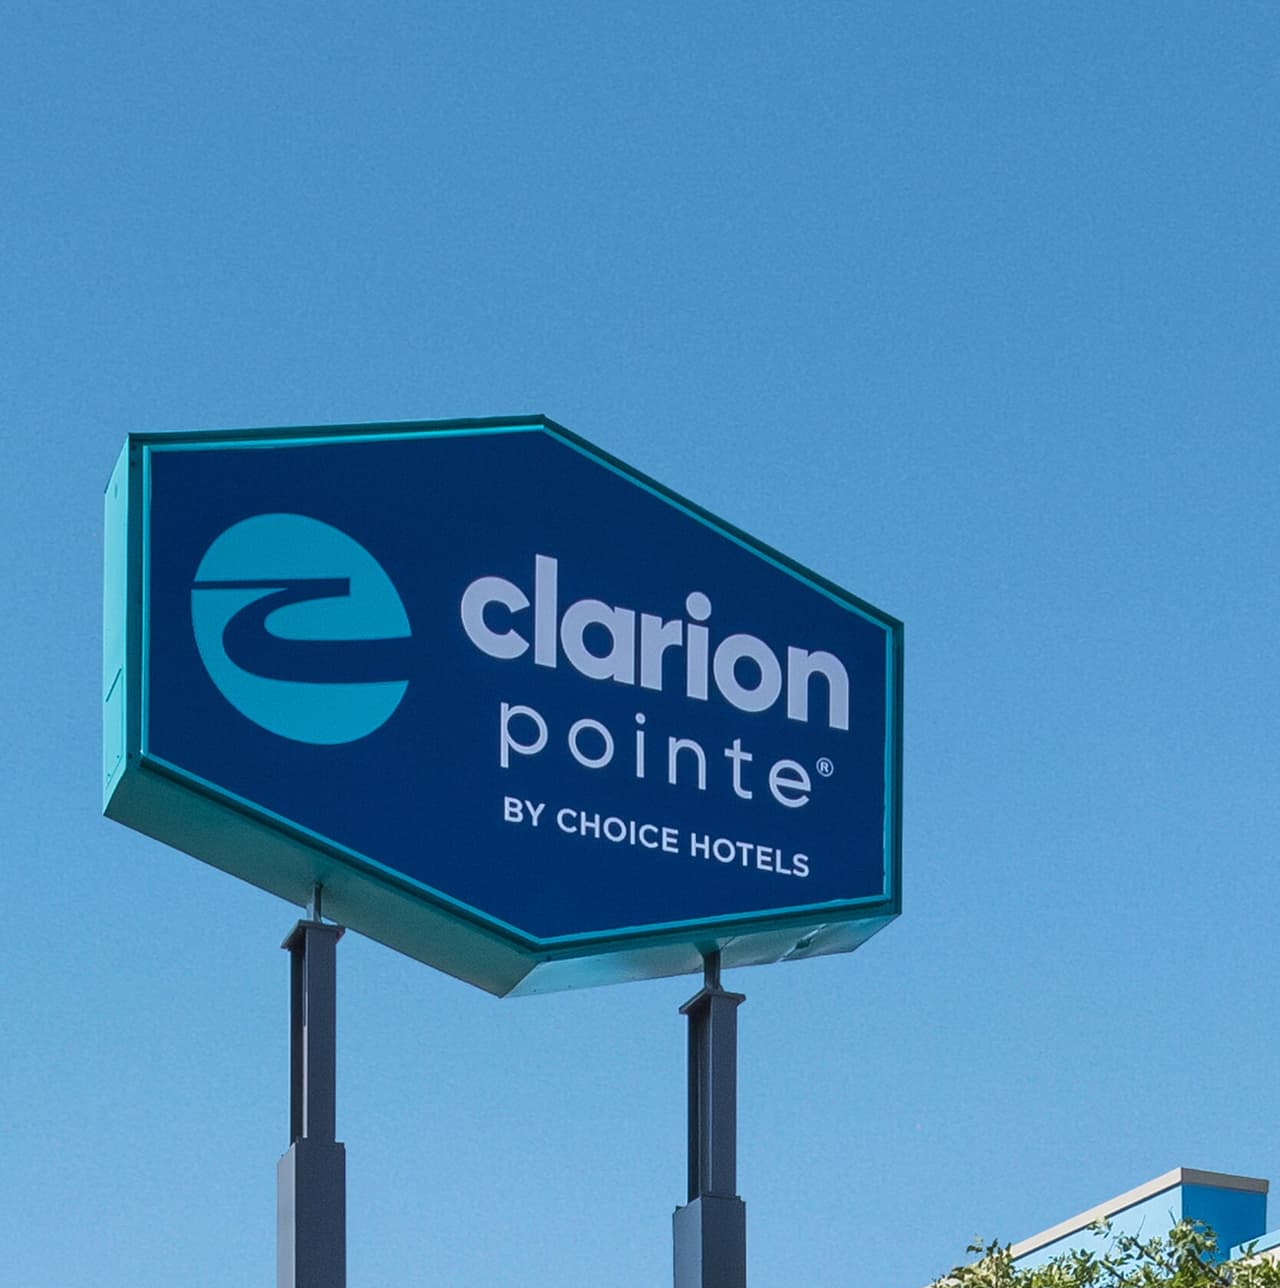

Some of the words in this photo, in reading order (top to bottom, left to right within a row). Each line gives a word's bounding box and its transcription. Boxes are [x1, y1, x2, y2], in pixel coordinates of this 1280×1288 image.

[460, 553, 850, 731] clarion
[503, 795, 546, 827] BY
[556, 808, 679, 854] CHOICE
[690, 832, 810, 878] HOTELS
